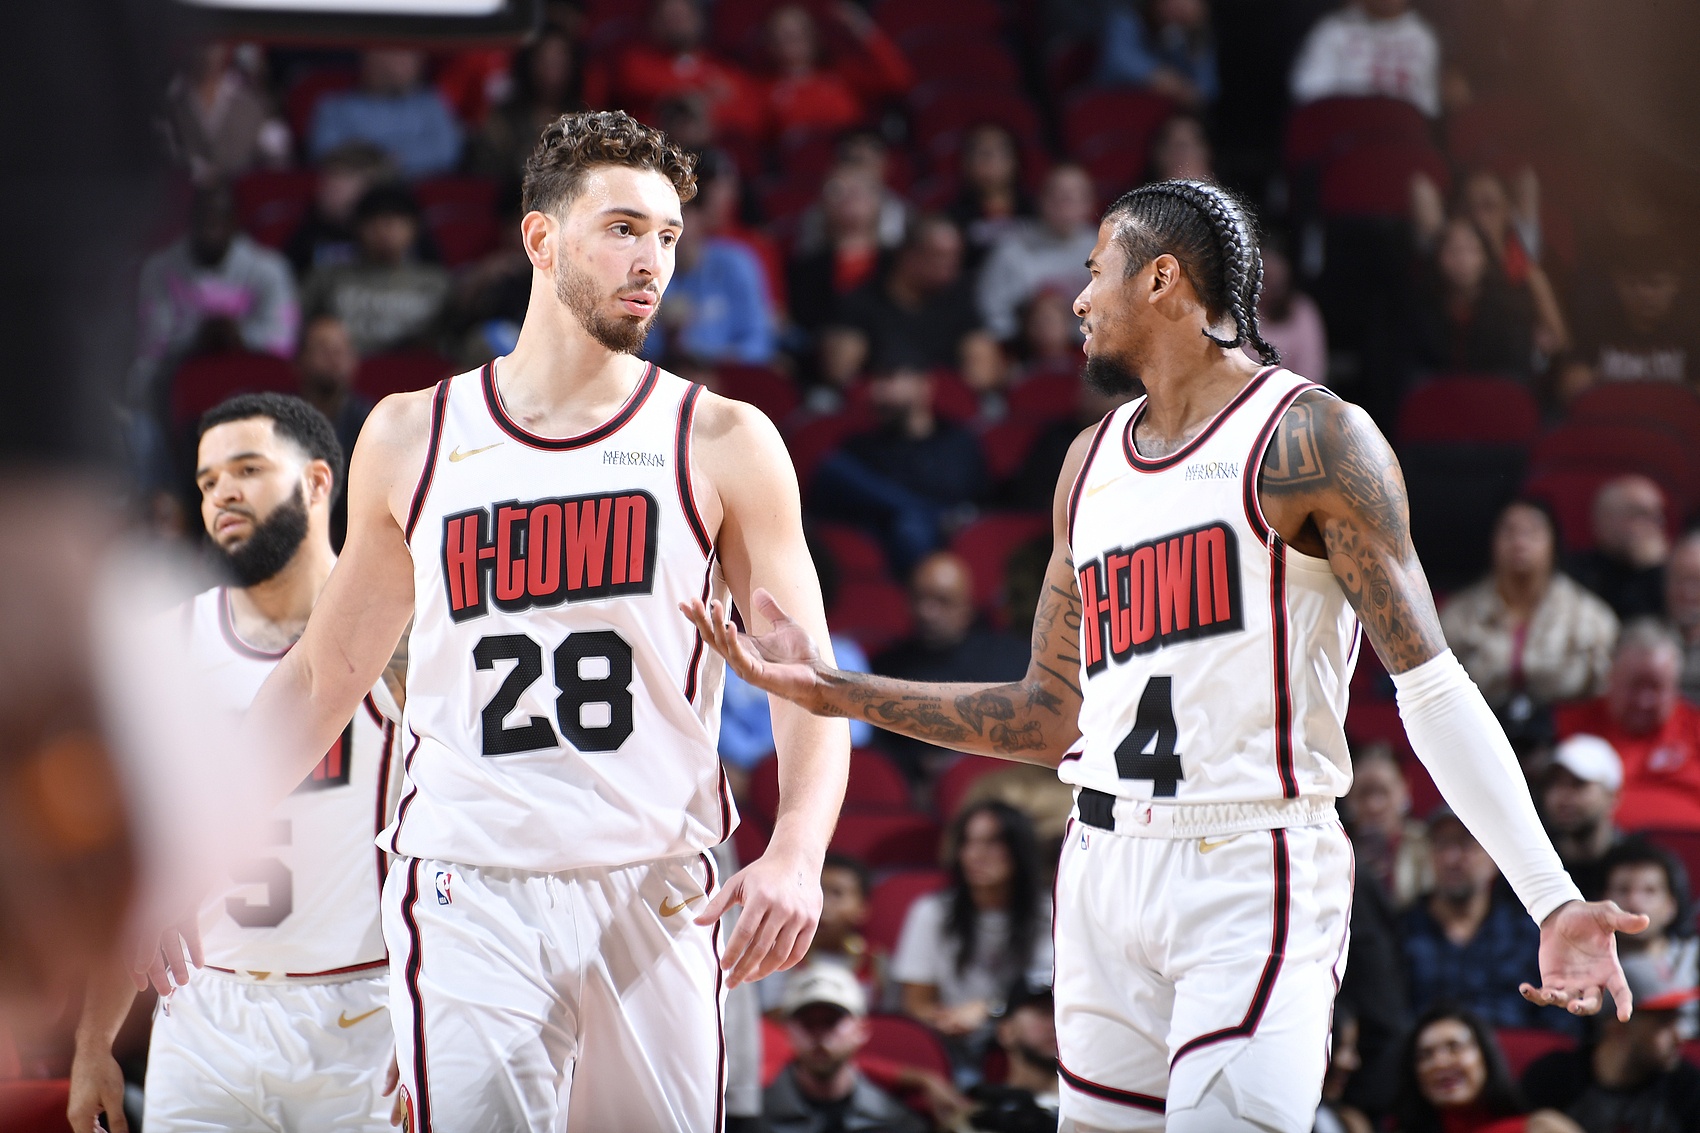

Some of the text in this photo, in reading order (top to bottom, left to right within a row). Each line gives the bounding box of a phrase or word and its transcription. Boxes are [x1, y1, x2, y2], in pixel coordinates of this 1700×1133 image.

[603, 450, 664, 461] MEMORIAL
[603, 457, 665, 467] HERMANN
[1187, 462, 1238, 472] MEMORIAL
[1185, 469, 1239, 480] HERMANN
[472, 630, 634, 757] 28
[1114, 676, 1184, 797] 4
